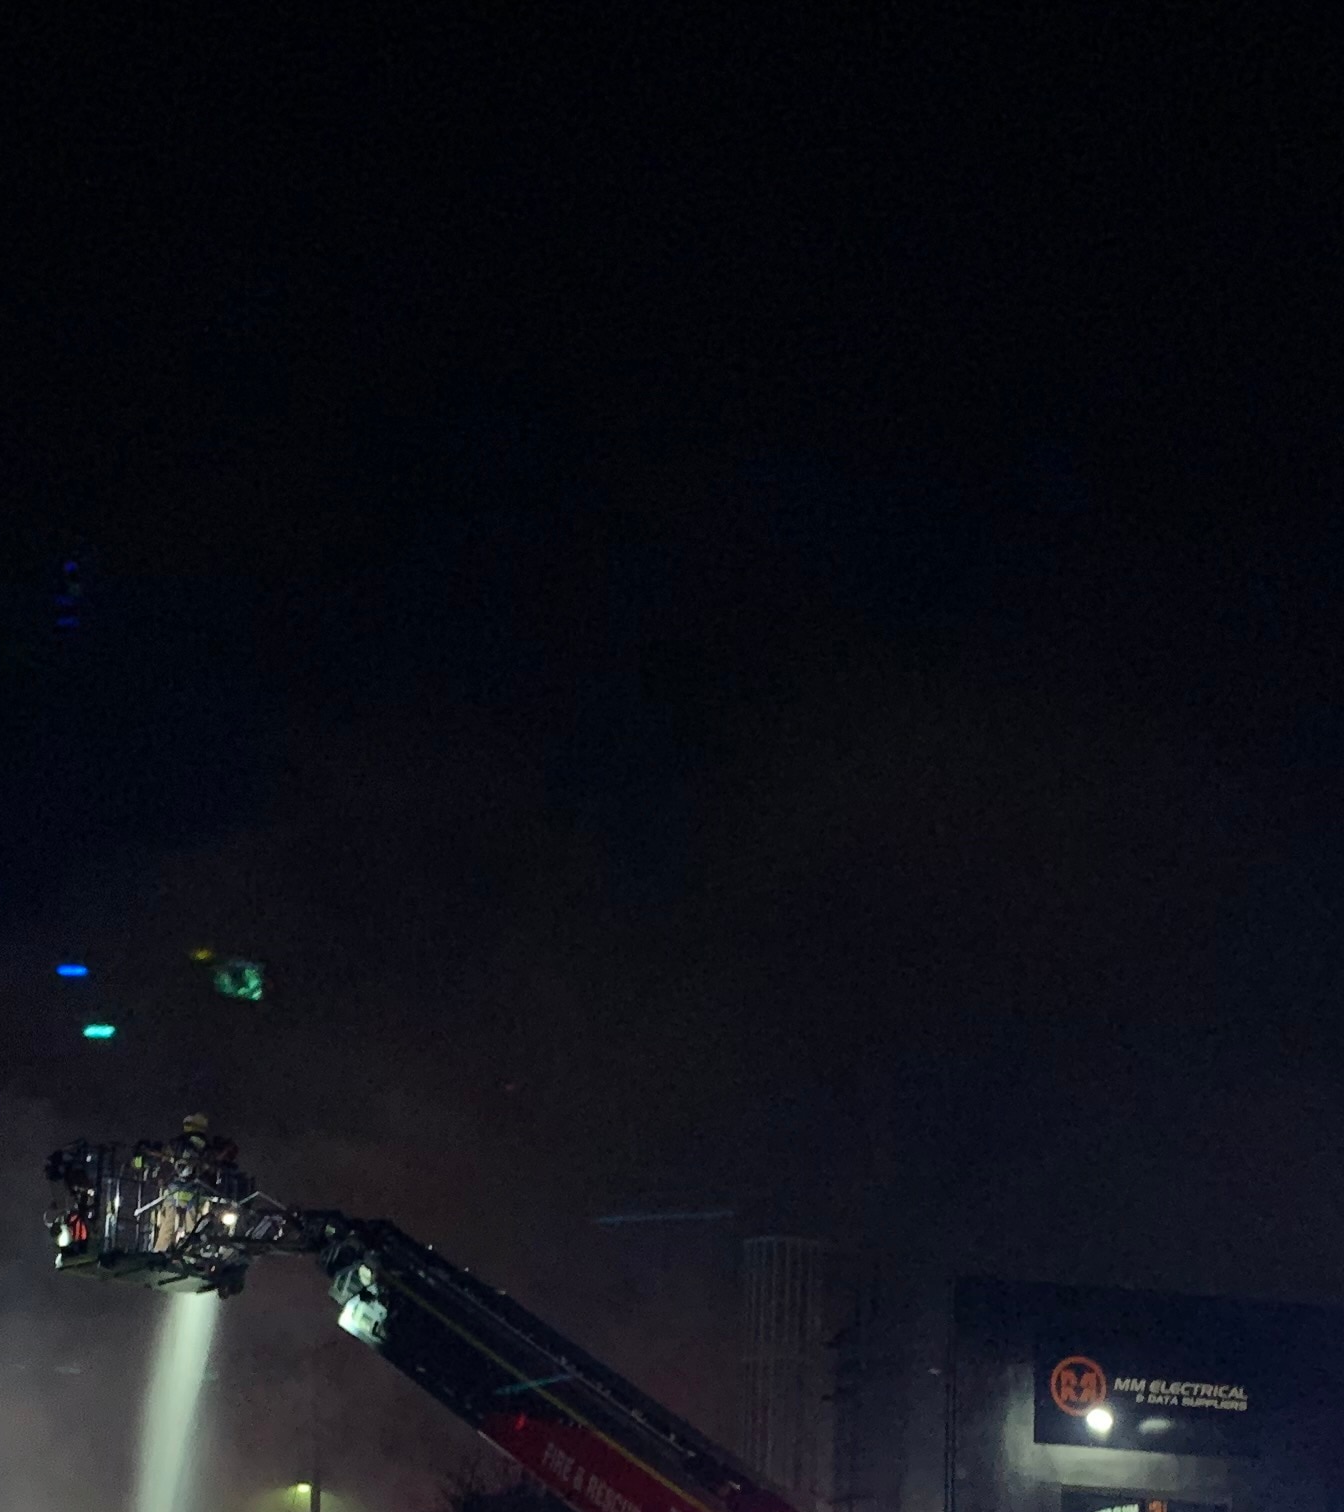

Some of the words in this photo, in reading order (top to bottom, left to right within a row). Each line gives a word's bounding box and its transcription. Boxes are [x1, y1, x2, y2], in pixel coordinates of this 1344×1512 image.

[1113, 1377, 1147, 1394] MM
[1148, 1379, 1248, 1401] ELECTRICAL
[1147, 1393, 1178, 1407] DATA
[1181, 1395, 1248, 1412] SUPPLIERS
[541, 1442, 576, 1482] FIRE
